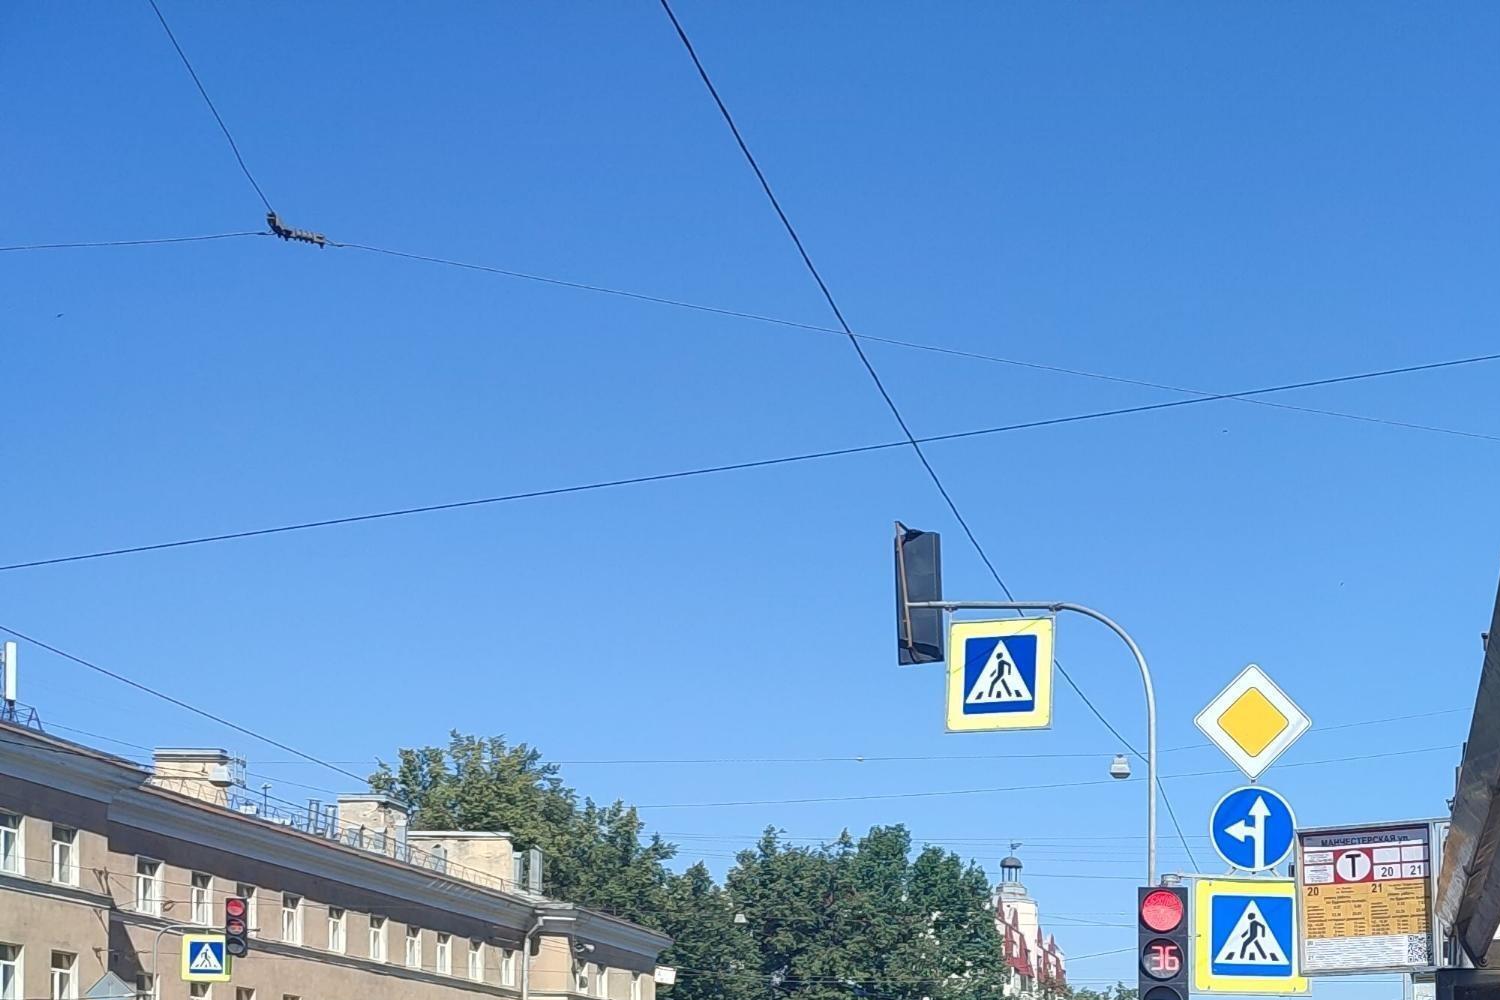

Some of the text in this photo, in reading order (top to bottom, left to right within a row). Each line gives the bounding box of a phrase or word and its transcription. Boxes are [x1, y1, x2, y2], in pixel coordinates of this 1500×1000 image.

[1321, 834, 1396, 847] МАНЧЕСТЕРСКАЯ
[1345, 853, 1362, 878] Т
[1381, 865, 1422, 877] 20 21
[1307, 887, 1319, 896] 20
[1371, 883, 1383, 893] 21
[1151, 946, 1179, 970] 36
